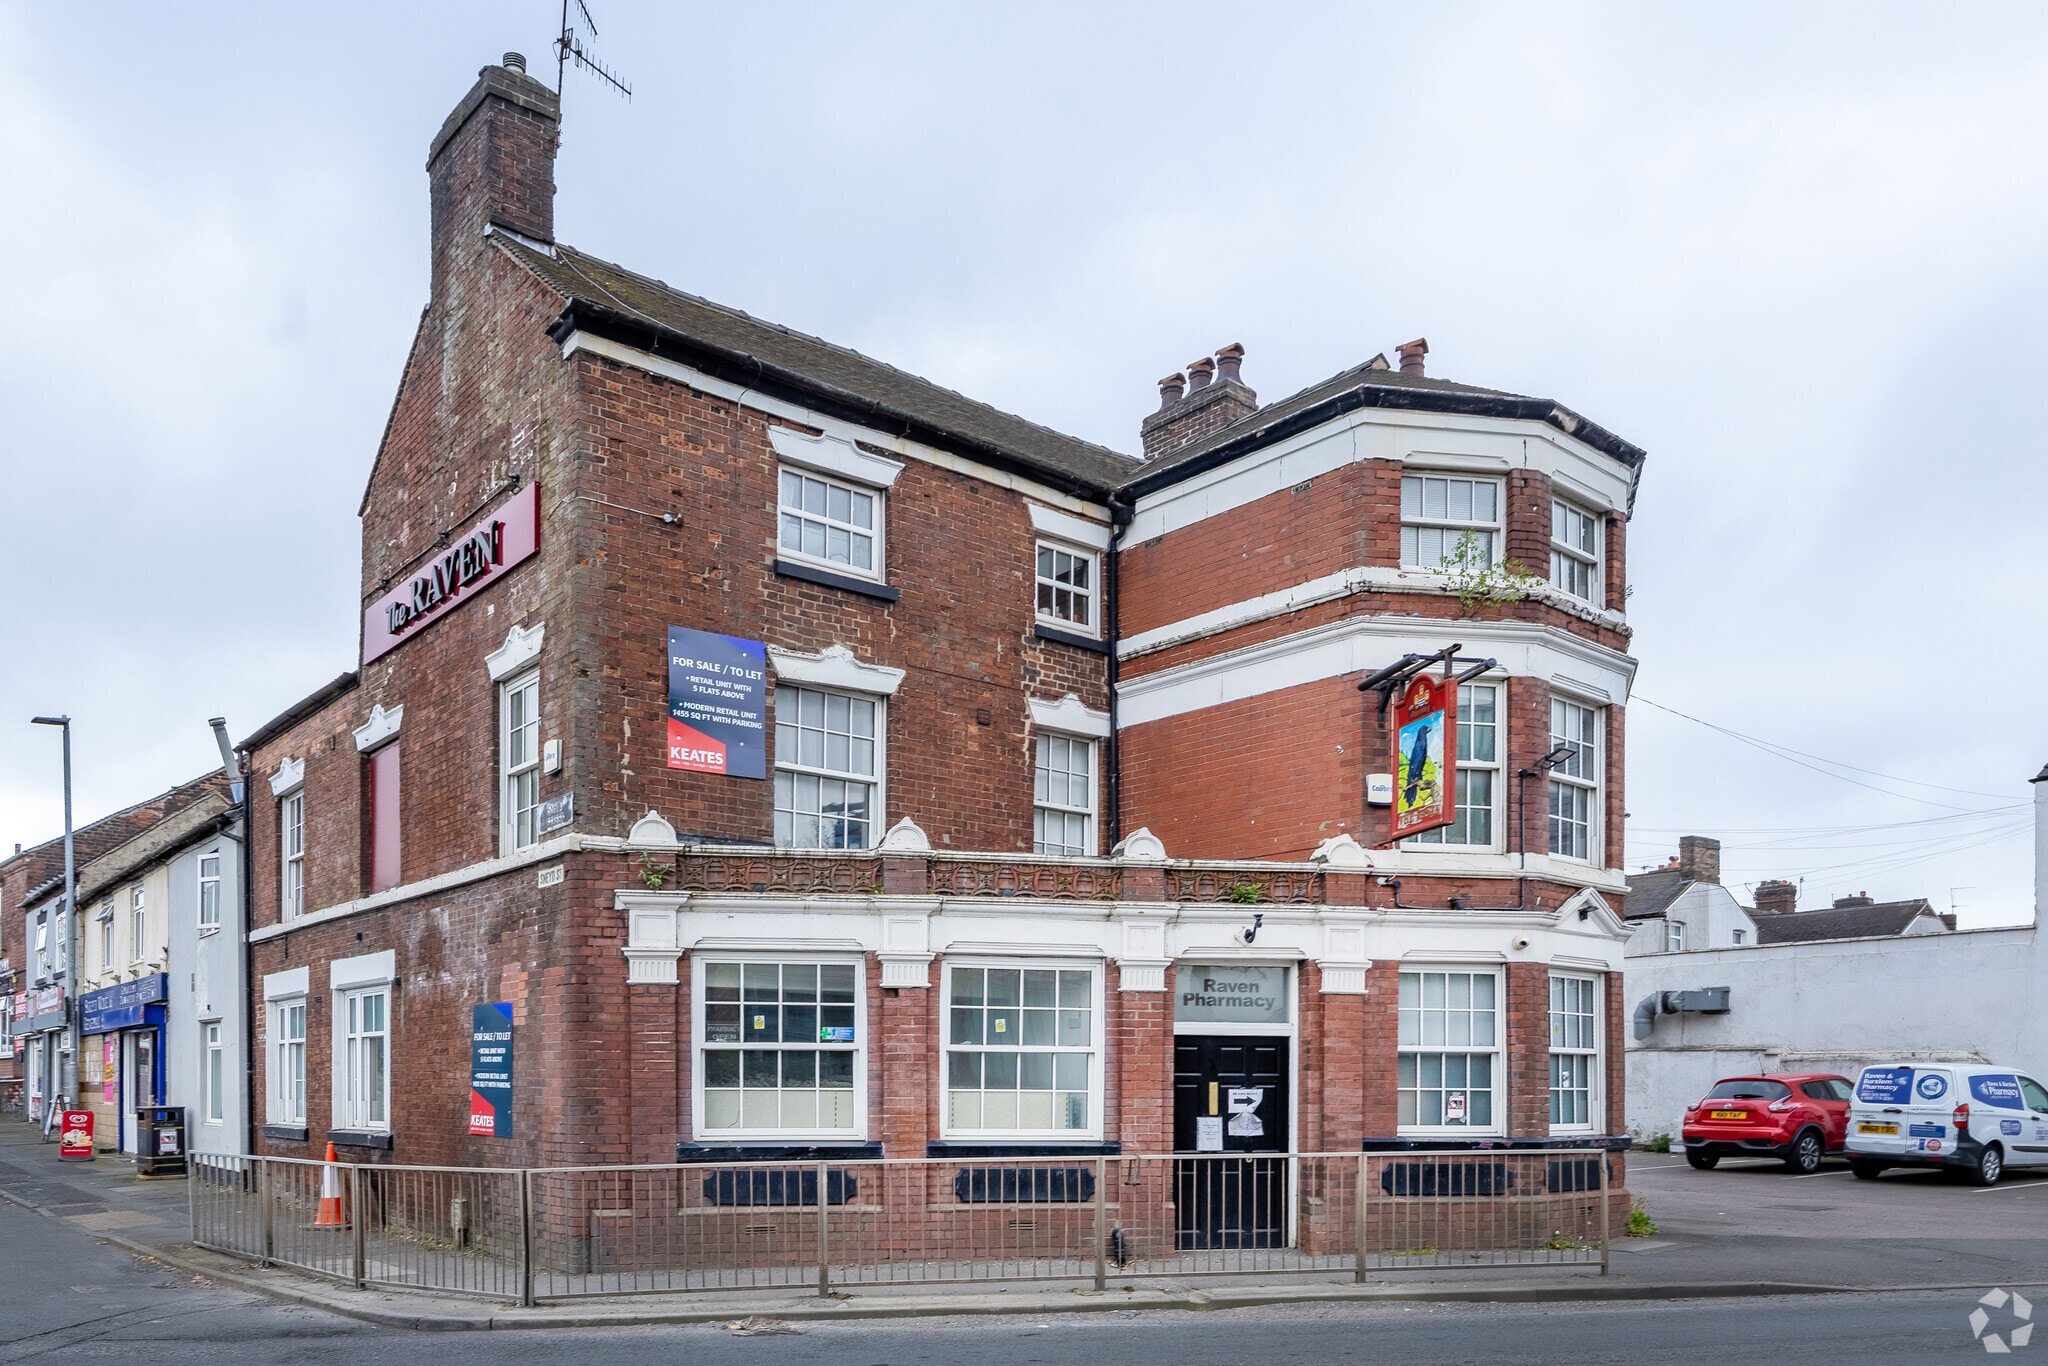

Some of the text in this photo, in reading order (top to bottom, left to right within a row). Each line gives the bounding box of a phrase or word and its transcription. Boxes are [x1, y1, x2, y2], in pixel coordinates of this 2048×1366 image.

[408, 520, 503, 620] RAVEN
[672, 656, 763, 680] FOR SALE / TO LET
[690, 676, 752, 692] RETAIL UNIT WITH
[699, 686, 720, 696] FLATS
[720, 688, 745, 700] ABOVE
[672, 709, 763, 730] 1455 SQ FT WITH PARKING
[684, 702, 758, 720] MODERN RETAIL UNIT
[670, 746, 724, 765] KEATES
[1203, 978, 1260, 993] Raven
[1183, 992, 1276, 1010] Pharmacy
[474, 1032, 482, 1041] FOR
[483, 1032, 493, 1040] SALE
[496, 1032, 502, 1040] TO
[502, 1032, 511, 1040] LET
[1989, 1087, 2019, 1097] Pharmacy
[470, 1114, 494, 1127] KEATES
